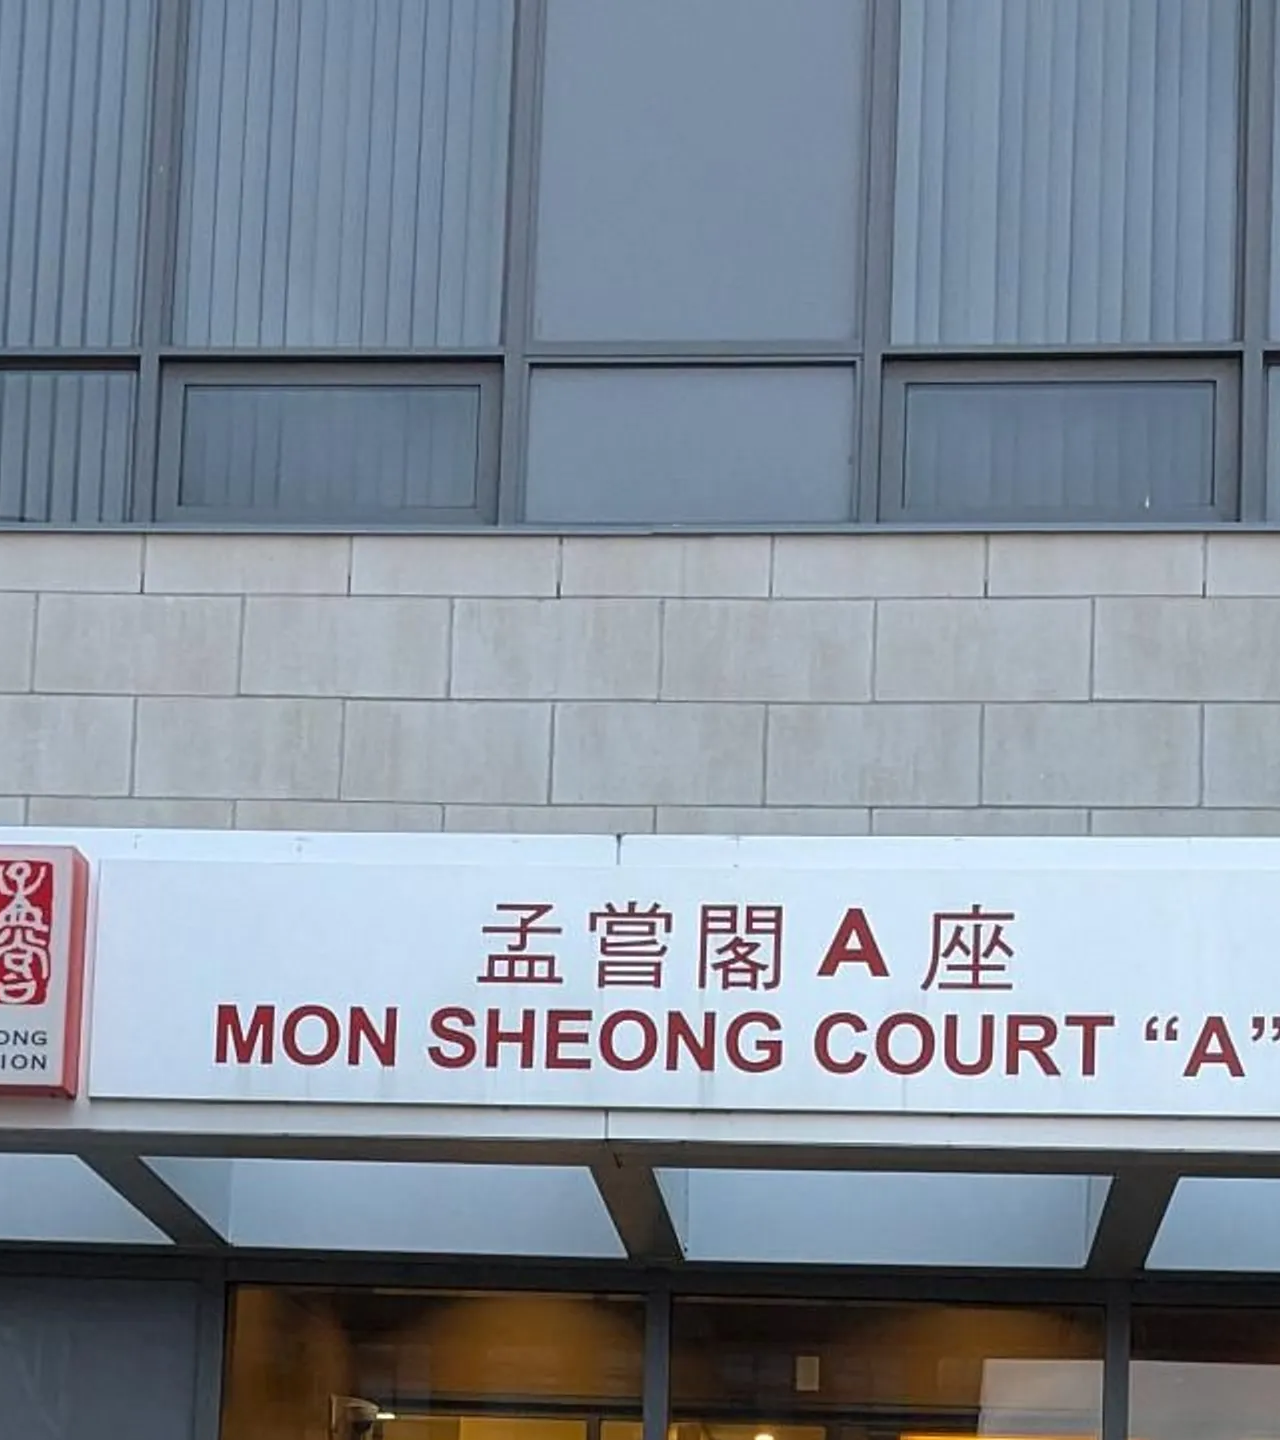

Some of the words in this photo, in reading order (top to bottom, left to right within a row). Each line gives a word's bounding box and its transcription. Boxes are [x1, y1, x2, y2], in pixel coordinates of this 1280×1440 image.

[214, 1004, 397, 1066] MON
[428, 1007, 782, 1072] SHEONG
[814, 1013, 1115, 1077] COURT
